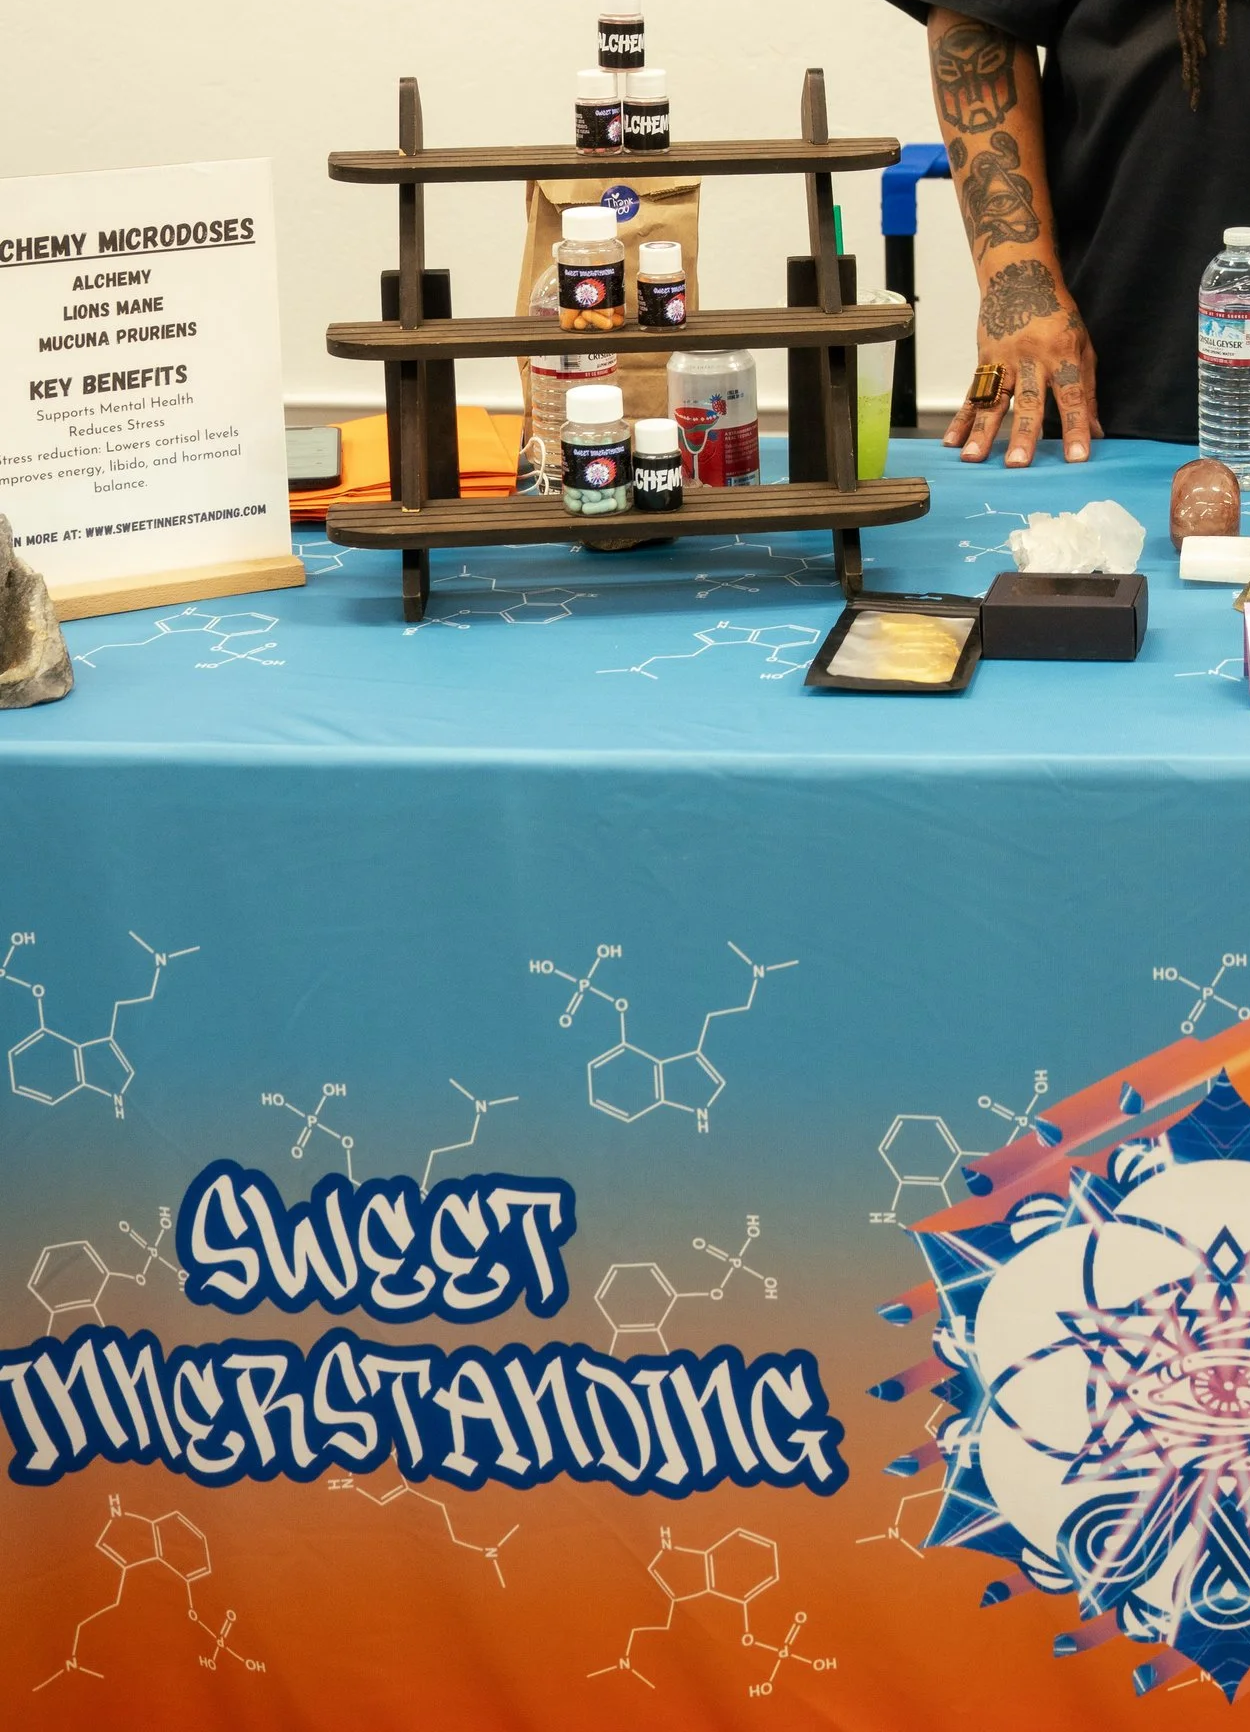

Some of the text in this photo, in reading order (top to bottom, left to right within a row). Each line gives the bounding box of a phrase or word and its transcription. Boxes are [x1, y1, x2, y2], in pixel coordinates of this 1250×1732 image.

[603, 197, 633, 208] Thank
[98, 217, 256, 255] MICRODOSES
[72, 269, 152, 292] ALCHEMY
[63, 296, 164, 322] LIONS MANE
[39, 321, 197, 353] MUCUNA PRURIENS
[1216, 339, 1242, 349] GEYSER
[29, 364, 188, 401] KEY BENEFITS
[36, 392, 194, 423] Supports Mental Health
[69, 418, 165, 437] Reduces Stress
[37, 446, 101, 461] reduction:
[106, 440, 151, 453] Lowers
[155, 429, 200, 447] cortisol
[205, 425, 239, 441] levels
[58, 465, 106, 483] energy,
[109, 456, 149, 472] libido,
[152, 451, 177, 467] and
[182, 443, 241, 463] hormonal
[93, 479, 148, 493] balance.
[26, 531, 58, 546] MORE
[62, 529, 82, 541] AT:
[85, 503, 267, 539] WWW.SWEETINNERSTANDING.COM
[11, 931, 36, 945] OH
[597, 944, 622, 958] OH
[1222, 953, 1248, 968] OH
[529, 960, 555, 974] HO
[1152, 967, 1180, 982] HO
[261, 1093, 285, 1107] HO
[322, 1083, 347, 1097] OH
[191, 1173, 563, 1311] SWEET
[0, 1337, 835, 1485] INNERSTANDING
